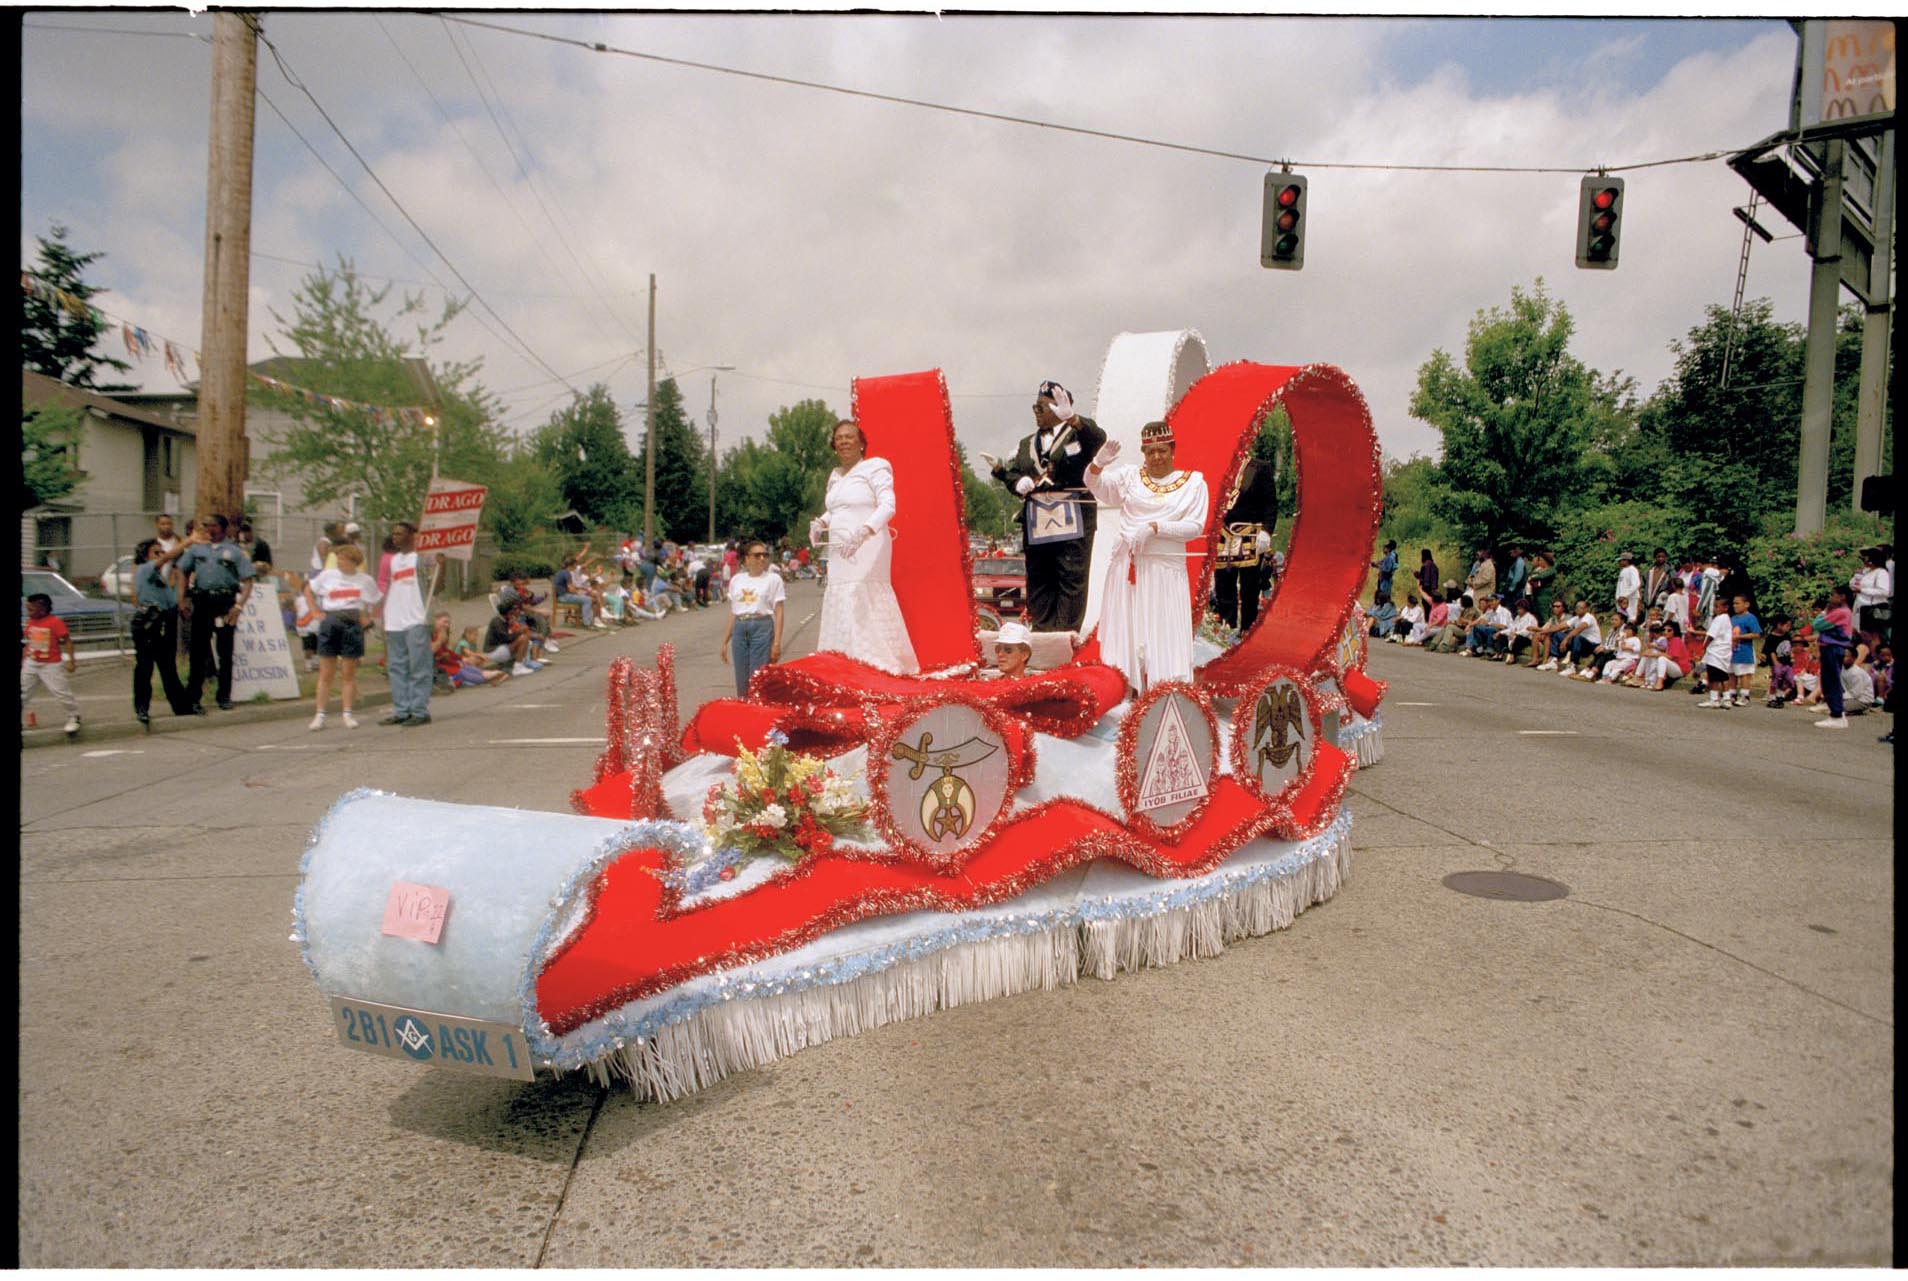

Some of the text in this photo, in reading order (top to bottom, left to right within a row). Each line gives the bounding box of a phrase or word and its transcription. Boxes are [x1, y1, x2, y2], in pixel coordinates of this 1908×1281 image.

[426, 493, 485, 512] DRAGO
[418, 528, 474, 549] DRAGO
[242, 638, 288, 653] WASH
[234, 665, 288, 682] JACKSON
[1144, 797, 1166, 807] IYOB
[341, 1006, 391, 1048] 2B1
[439, 1023, 494, 1067] ASK
[501, 1033, 518, 1069] 1
